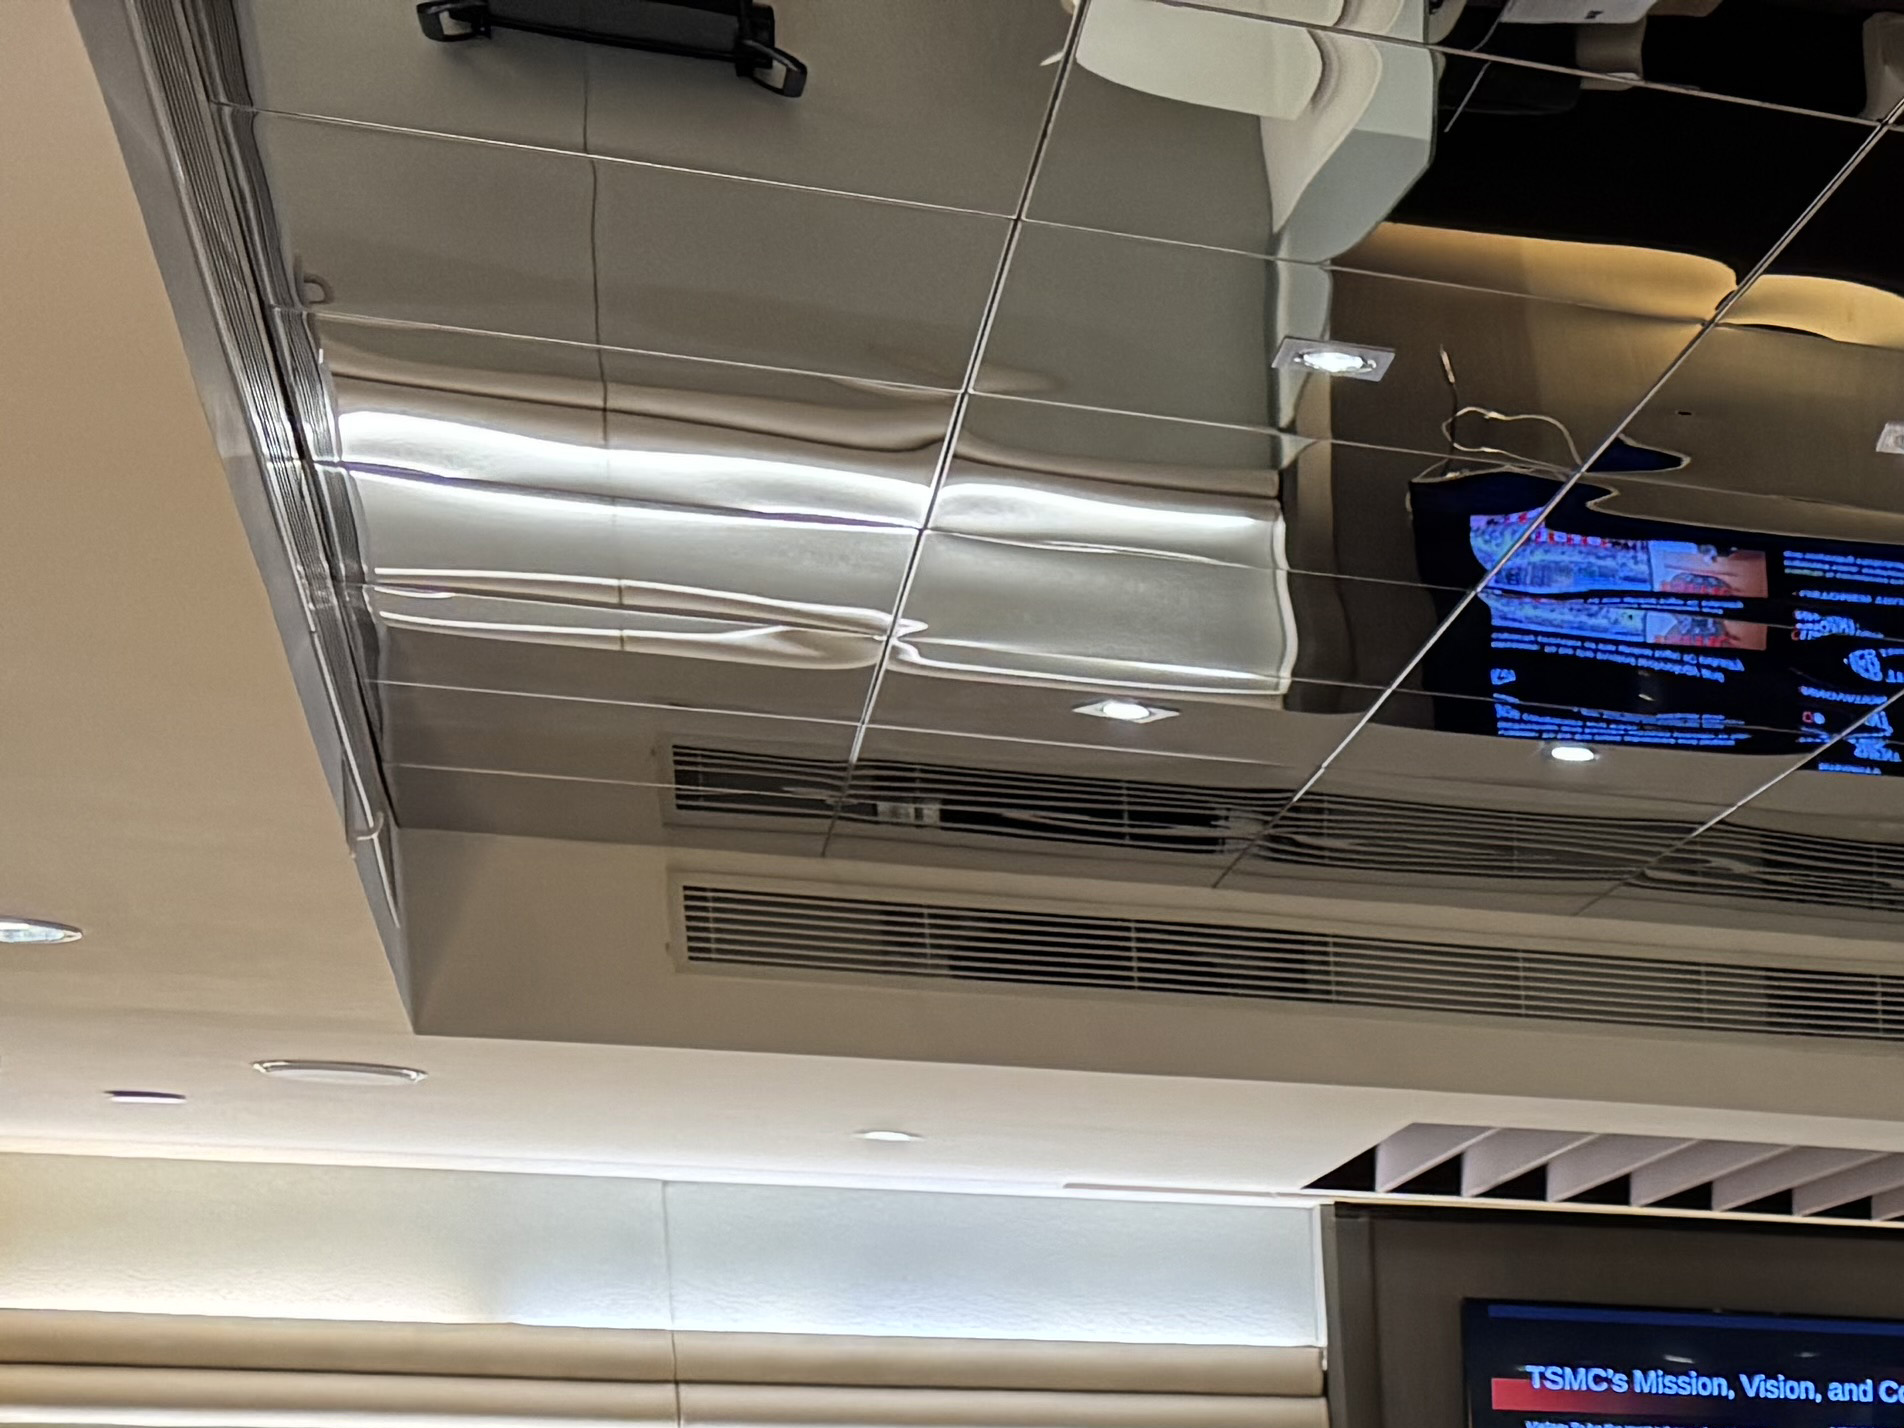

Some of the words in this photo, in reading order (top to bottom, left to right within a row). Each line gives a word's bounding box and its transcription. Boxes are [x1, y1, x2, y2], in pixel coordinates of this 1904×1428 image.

[1525, 1364, 1628, 1393] TSMC's
[1632, 1369, 1735, 1401] Mission,
[1739, 1374, 1823, 1404] Vision,
[1828, 1379, 1873, 1403] and
